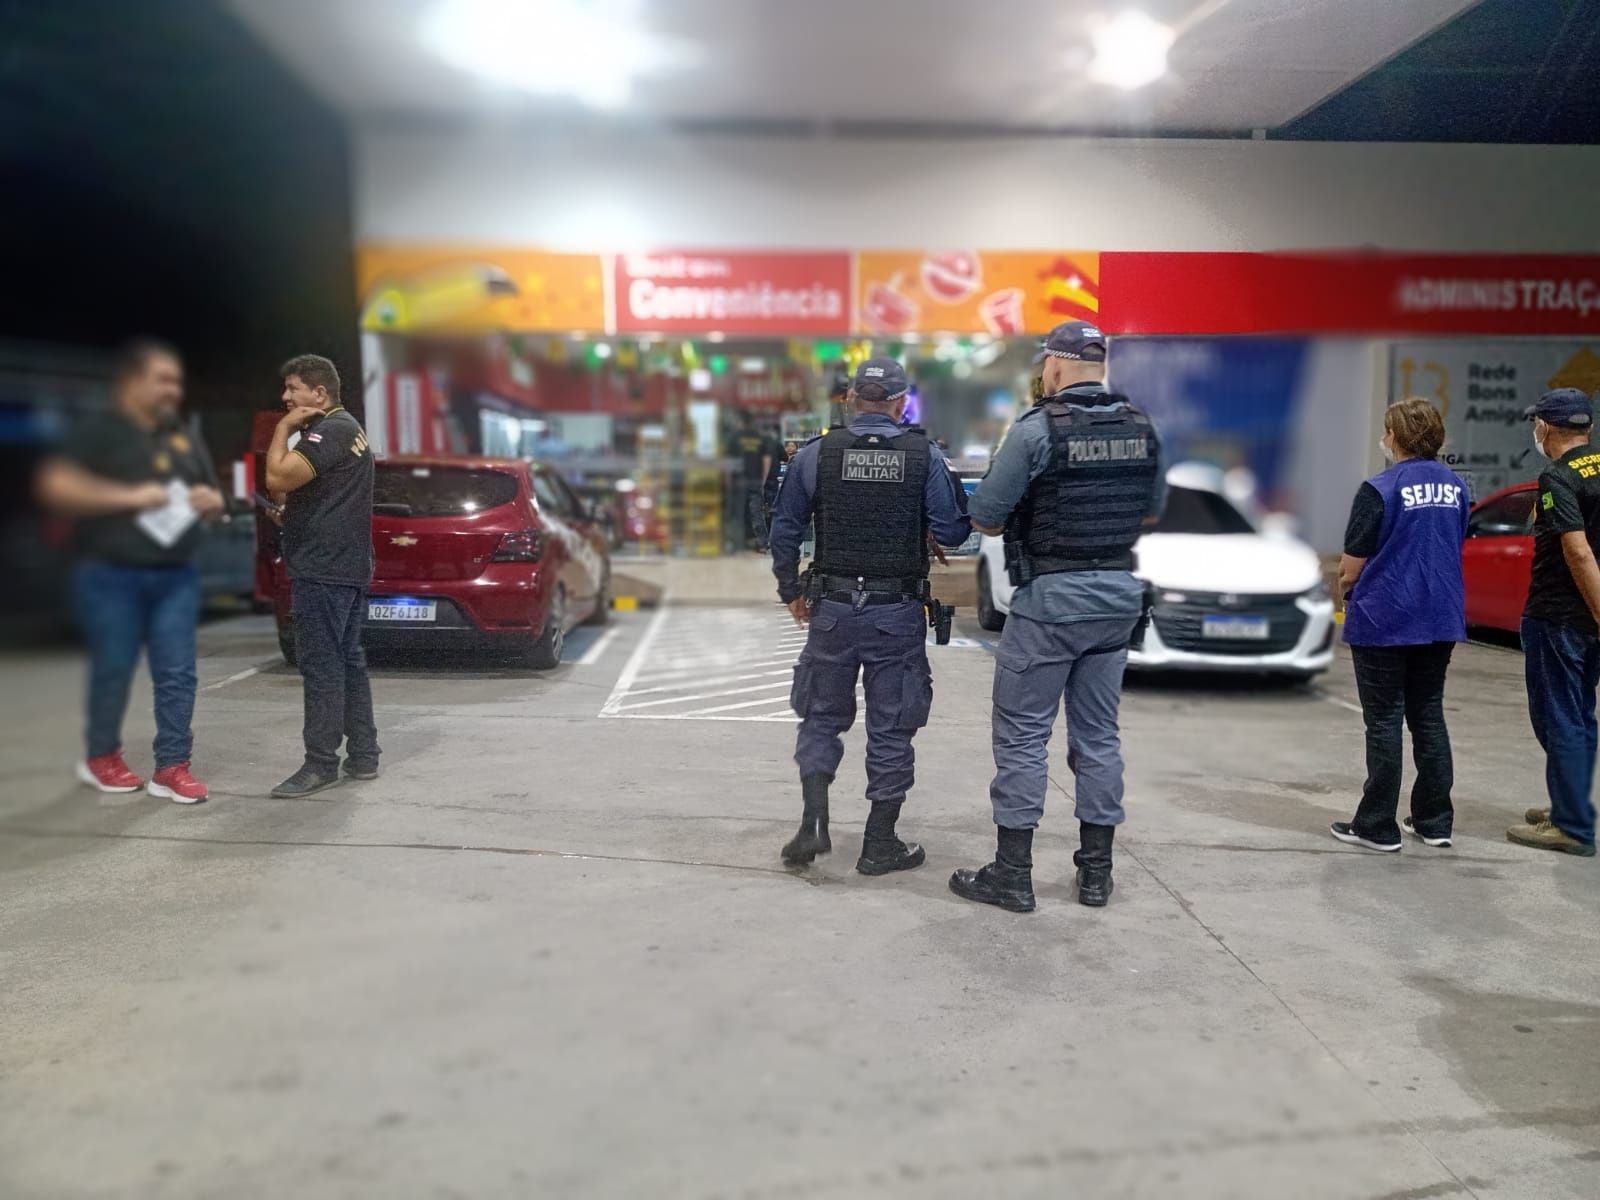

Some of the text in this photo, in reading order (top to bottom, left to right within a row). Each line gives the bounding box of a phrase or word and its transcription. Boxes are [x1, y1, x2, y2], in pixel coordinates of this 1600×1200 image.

[1398, 279, 1600, 316] ADMINISTRAÇ
[1468, 363, 1516, 380] Rede
[1468, 383, 1516, 400] Bons
[847, 452, 900, 466] POLÍCIA
[847, 466, 899, 479] MILITAR
[1579, 466, 1597, 478] DE
